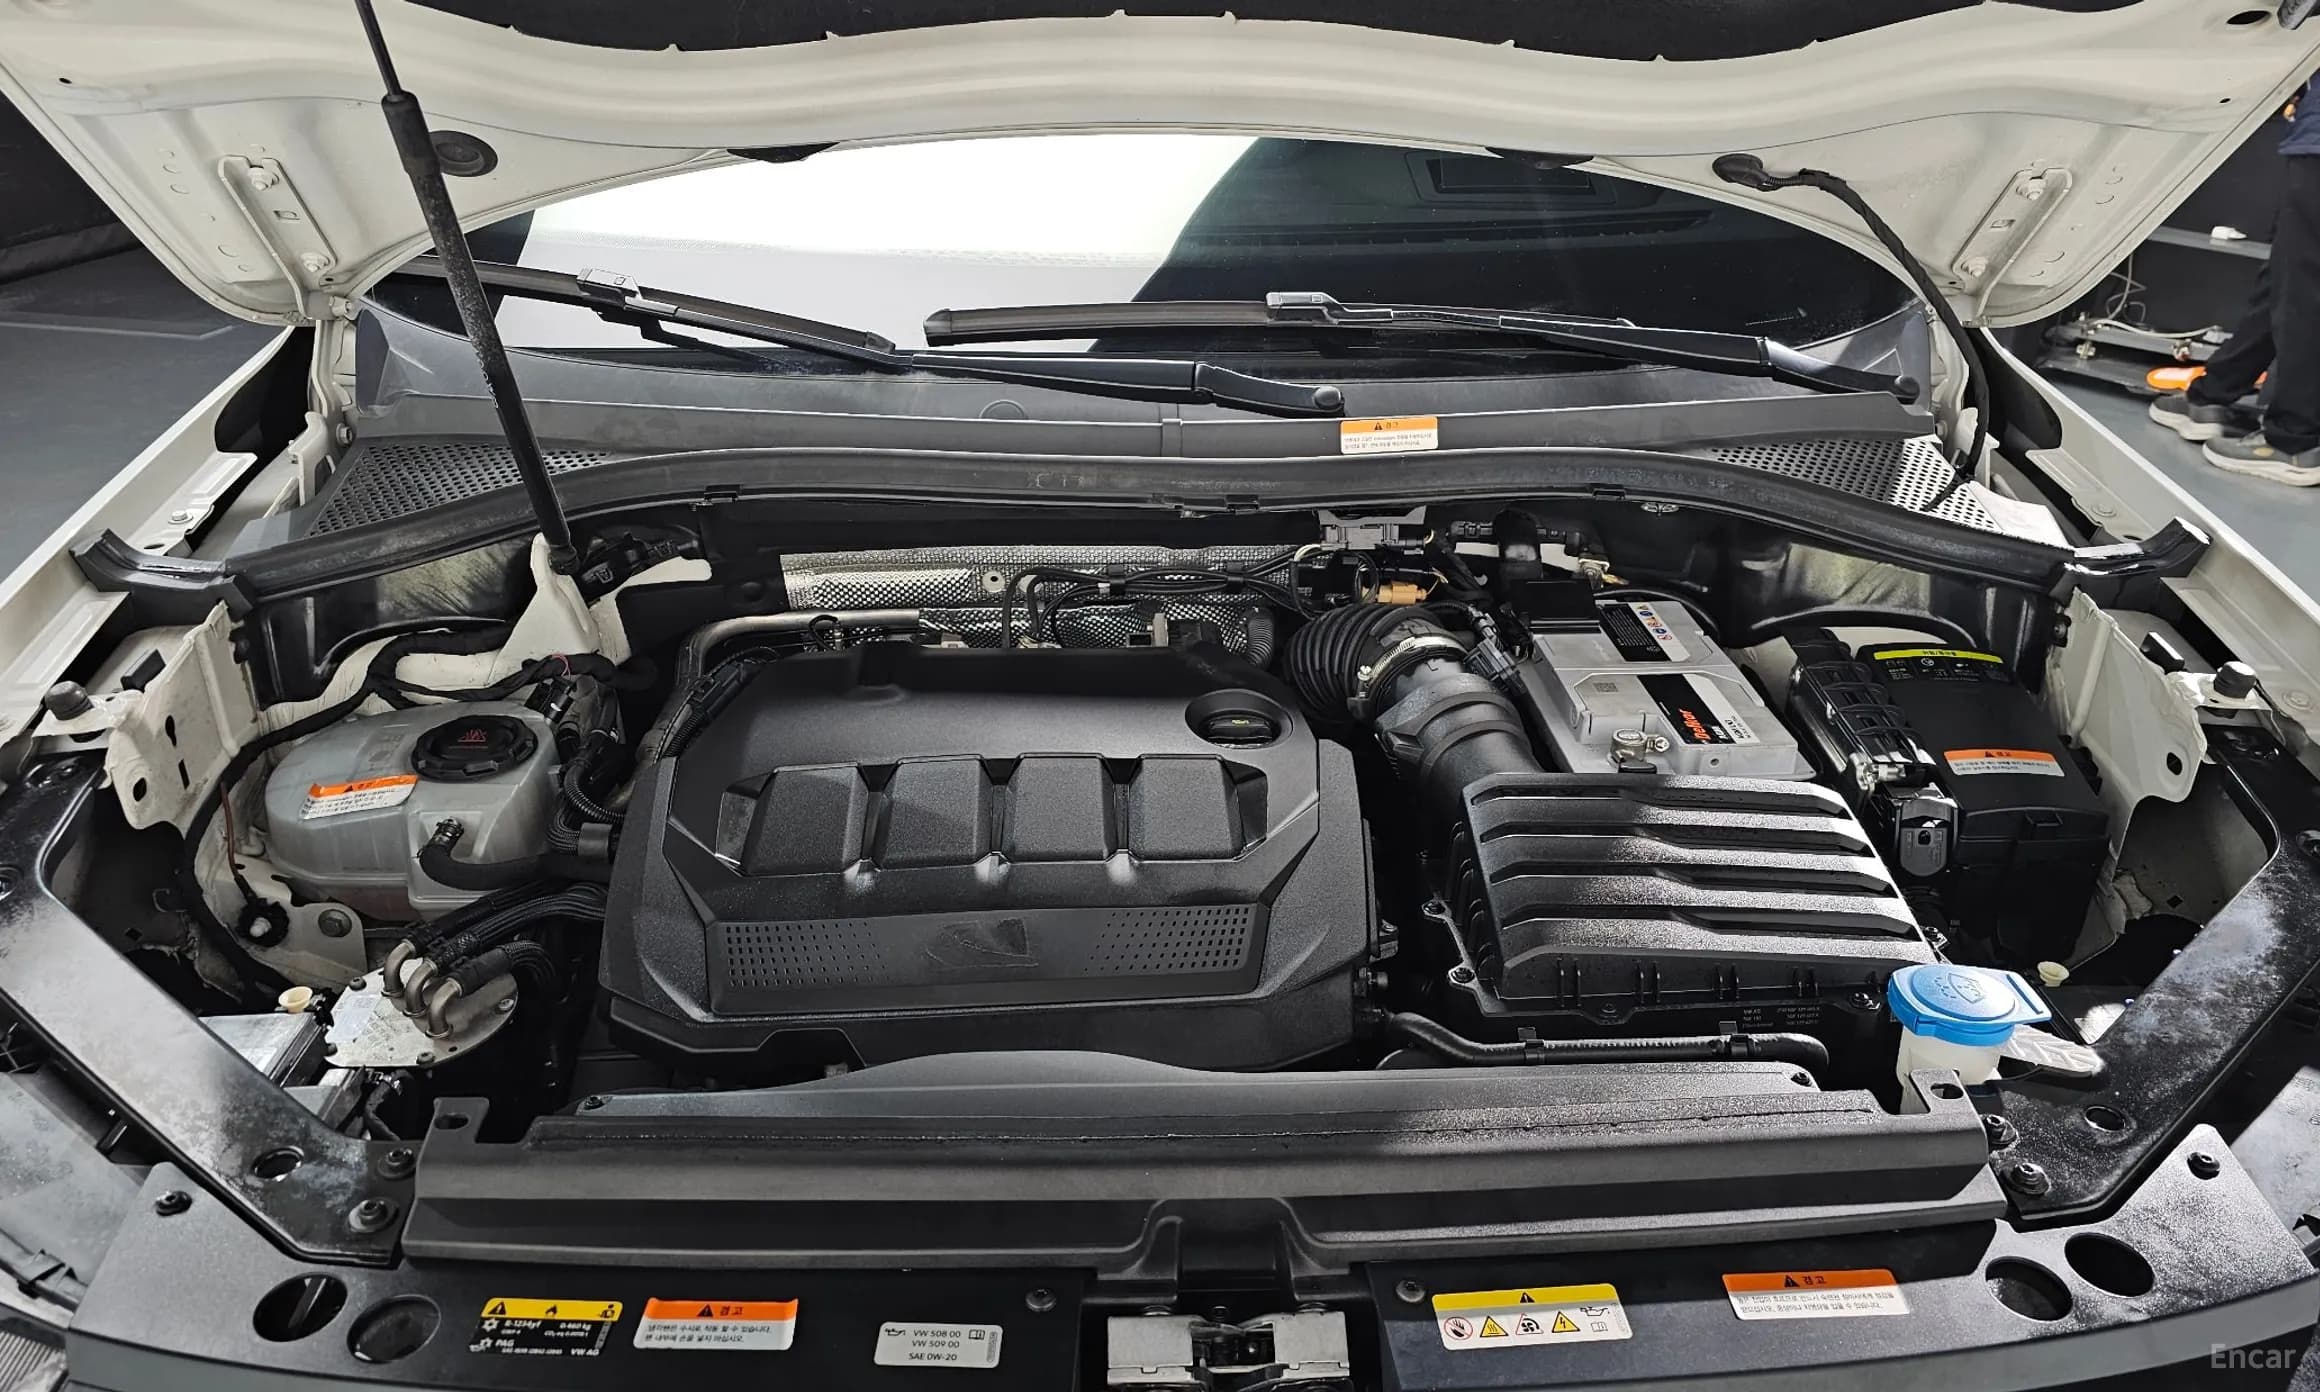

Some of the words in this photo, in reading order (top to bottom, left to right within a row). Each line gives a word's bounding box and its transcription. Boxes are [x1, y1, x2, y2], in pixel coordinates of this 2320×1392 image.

[720, 1305, 743, 1317] 경고
[913, 1329, 930, 1337] VW
[930, 1330, 947, 1338] 508
[949, 1330, 961, 1338] 00
[495, 1338, 515, 1347] PAG
[912, 1340, 926, 1348] VW
[929, 1340, 946, 1348] 509
[909, 1352, 925, 1360] SAE
[927, 1353, 957, 1361] 0W-20
